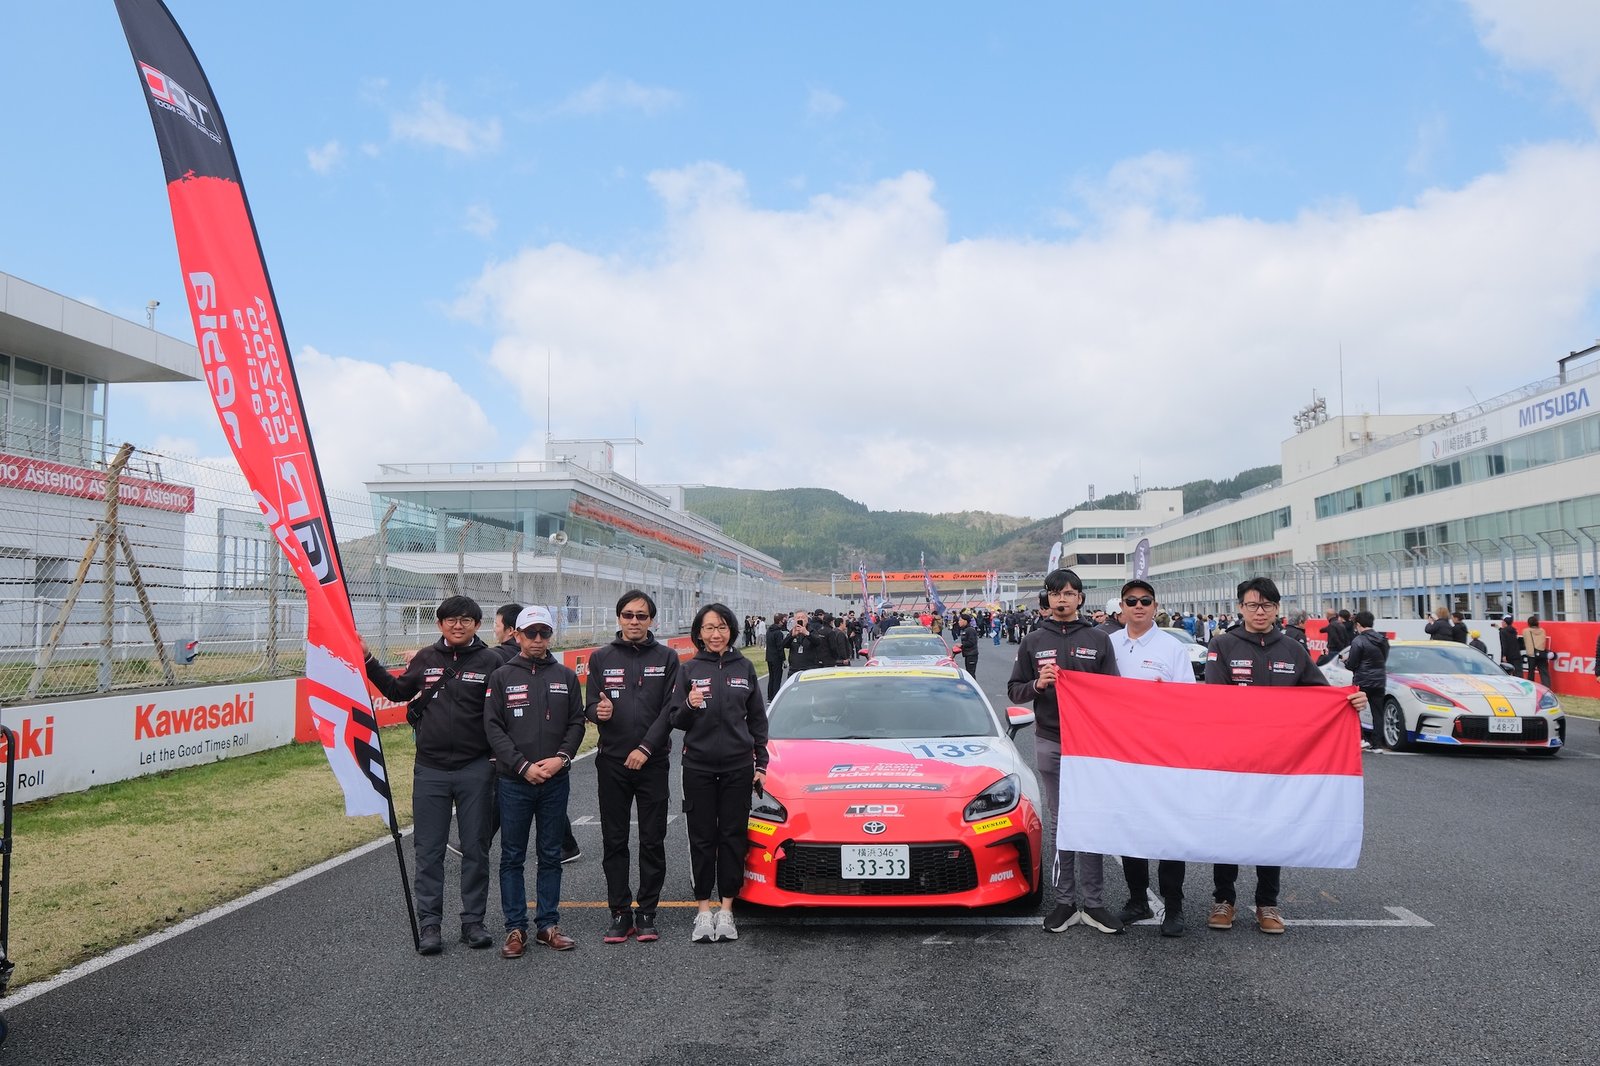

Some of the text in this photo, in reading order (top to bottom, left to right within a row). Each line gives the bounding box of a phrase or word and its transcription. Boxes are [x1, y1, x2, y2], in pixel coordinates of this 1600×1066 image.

[1519, 387, 1590, 428] MITSUBA
[24, 464, 84, 492] Astemo
[88, 476, 140, 500] Asmo
[144, 487, 189, 508] Astemo
[134, 692, 254, 741] Kawasaki
[1496, 722, 1520, 732] 48-21
[140, 733, 249, 765] Let the Good Times Roll
[827, 770, 924, 778] Indonesia
[831, 764, 870, 773] GR
[18, 769, 45, 790] Roll
[851, 804, 899, 814] TCD
[982, 820, 1008, 830] DUNLOP
[877, 848, 894, 857] 346
[857, 859, 906, 876] 33-33
[989, 869, 1014, 883] MOTUL
